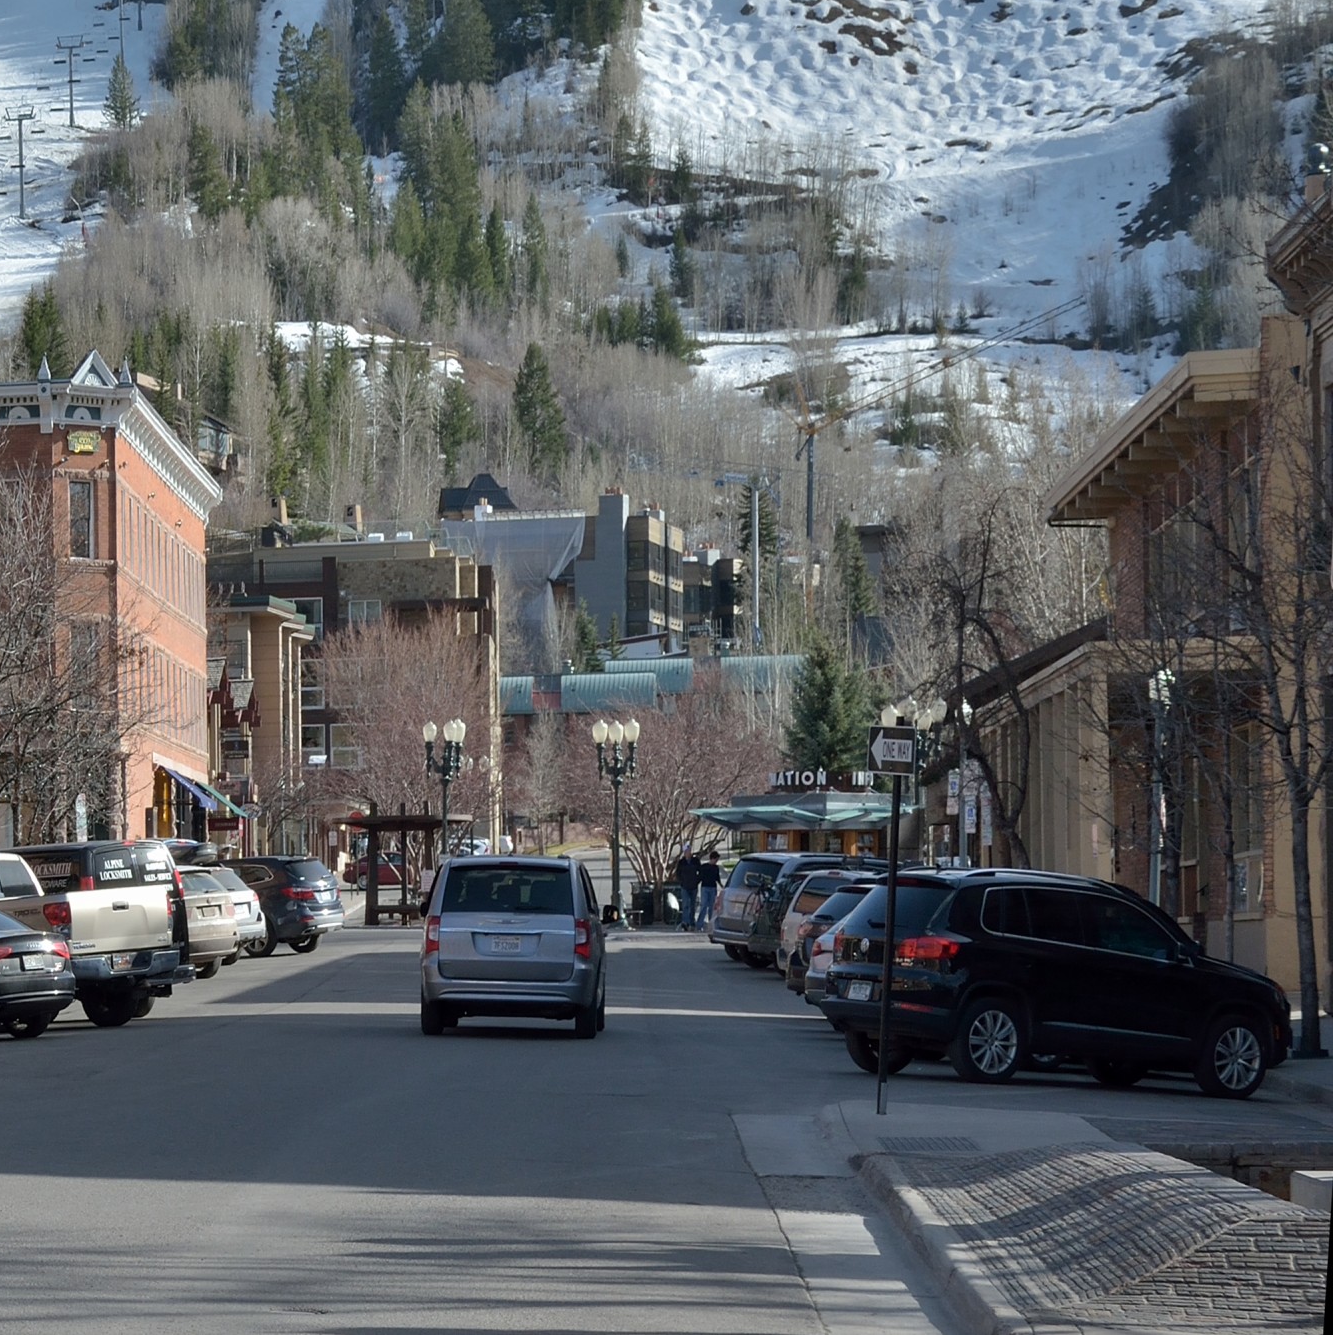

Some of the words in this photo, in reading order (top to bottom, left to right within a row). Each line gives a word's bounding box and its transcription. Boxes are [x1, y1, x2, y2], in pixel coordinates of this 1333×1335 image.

[883, 740, 895, 759] ONE
[897, 741, 911, 760] WAY
[32, 862, 71, 875] OCKSMITH
[104, 859, 124, 869] ALPINE
[99, 869, 132, 881] LOCKSMITH
[40, 879, 67, 888] RDWARE
